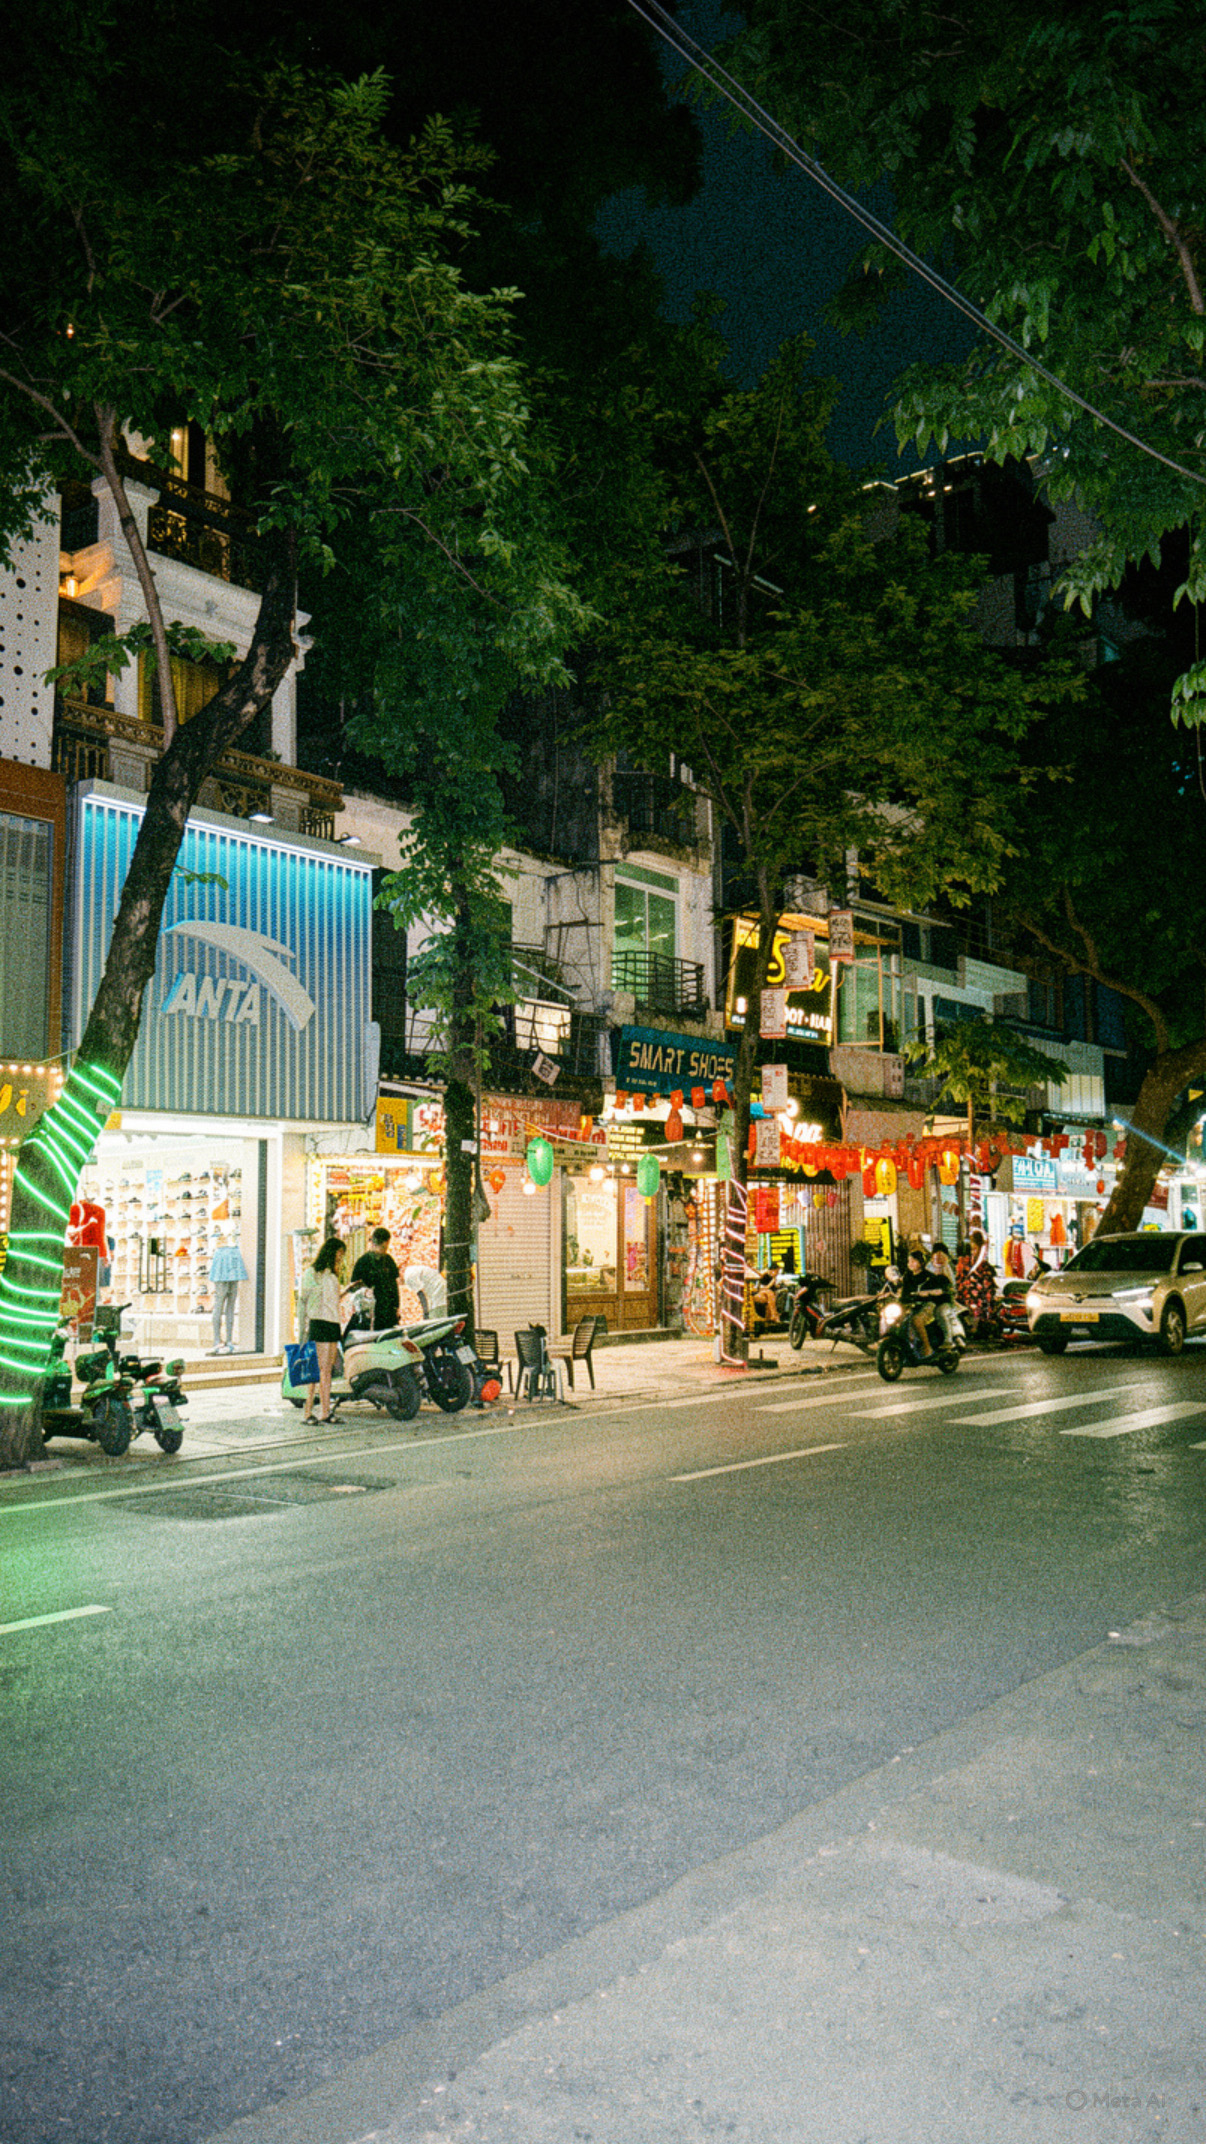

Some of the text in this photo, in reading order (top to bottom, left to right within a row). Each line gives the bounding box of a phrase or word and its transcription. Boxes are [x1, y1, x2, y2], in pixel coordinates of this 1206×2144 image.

[162, 972, 260, 1025] ANTA
[629, 1041, 735, 1082] SMART SHOES
